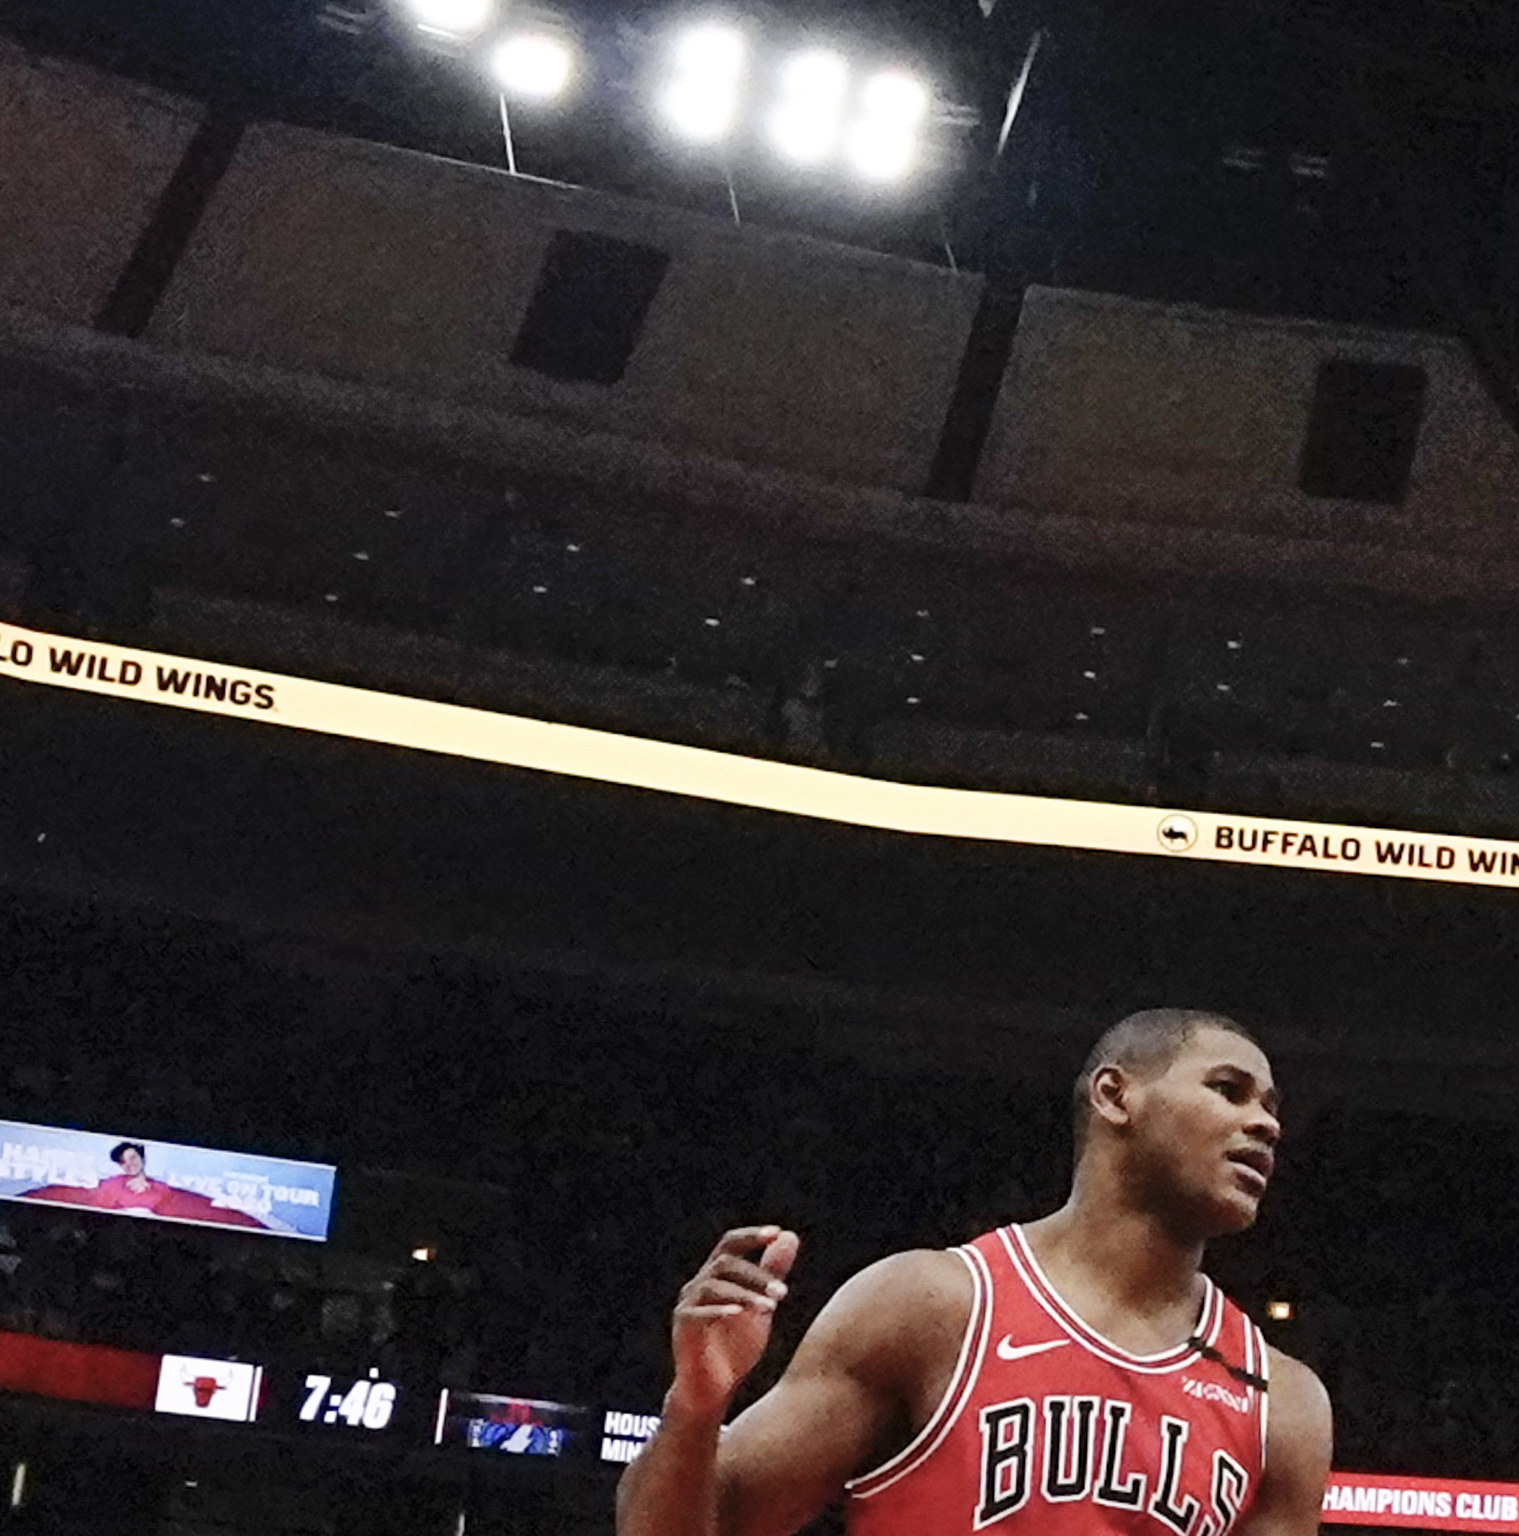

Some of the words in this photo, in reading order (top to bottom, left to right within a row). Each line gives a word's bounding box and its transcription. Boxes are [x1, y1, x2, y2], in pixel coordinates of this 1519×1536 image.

[49, 647, 143, 686] WILD
[156, 665, 275, 710] WINGS
[1214, 825, 1362, 863] BUFFALO
[1375, 839, 1456, 871] WILD
[299, 1375, 396, 1429] 7:46
[1456, 1493, 1519, 1521] CLUB
